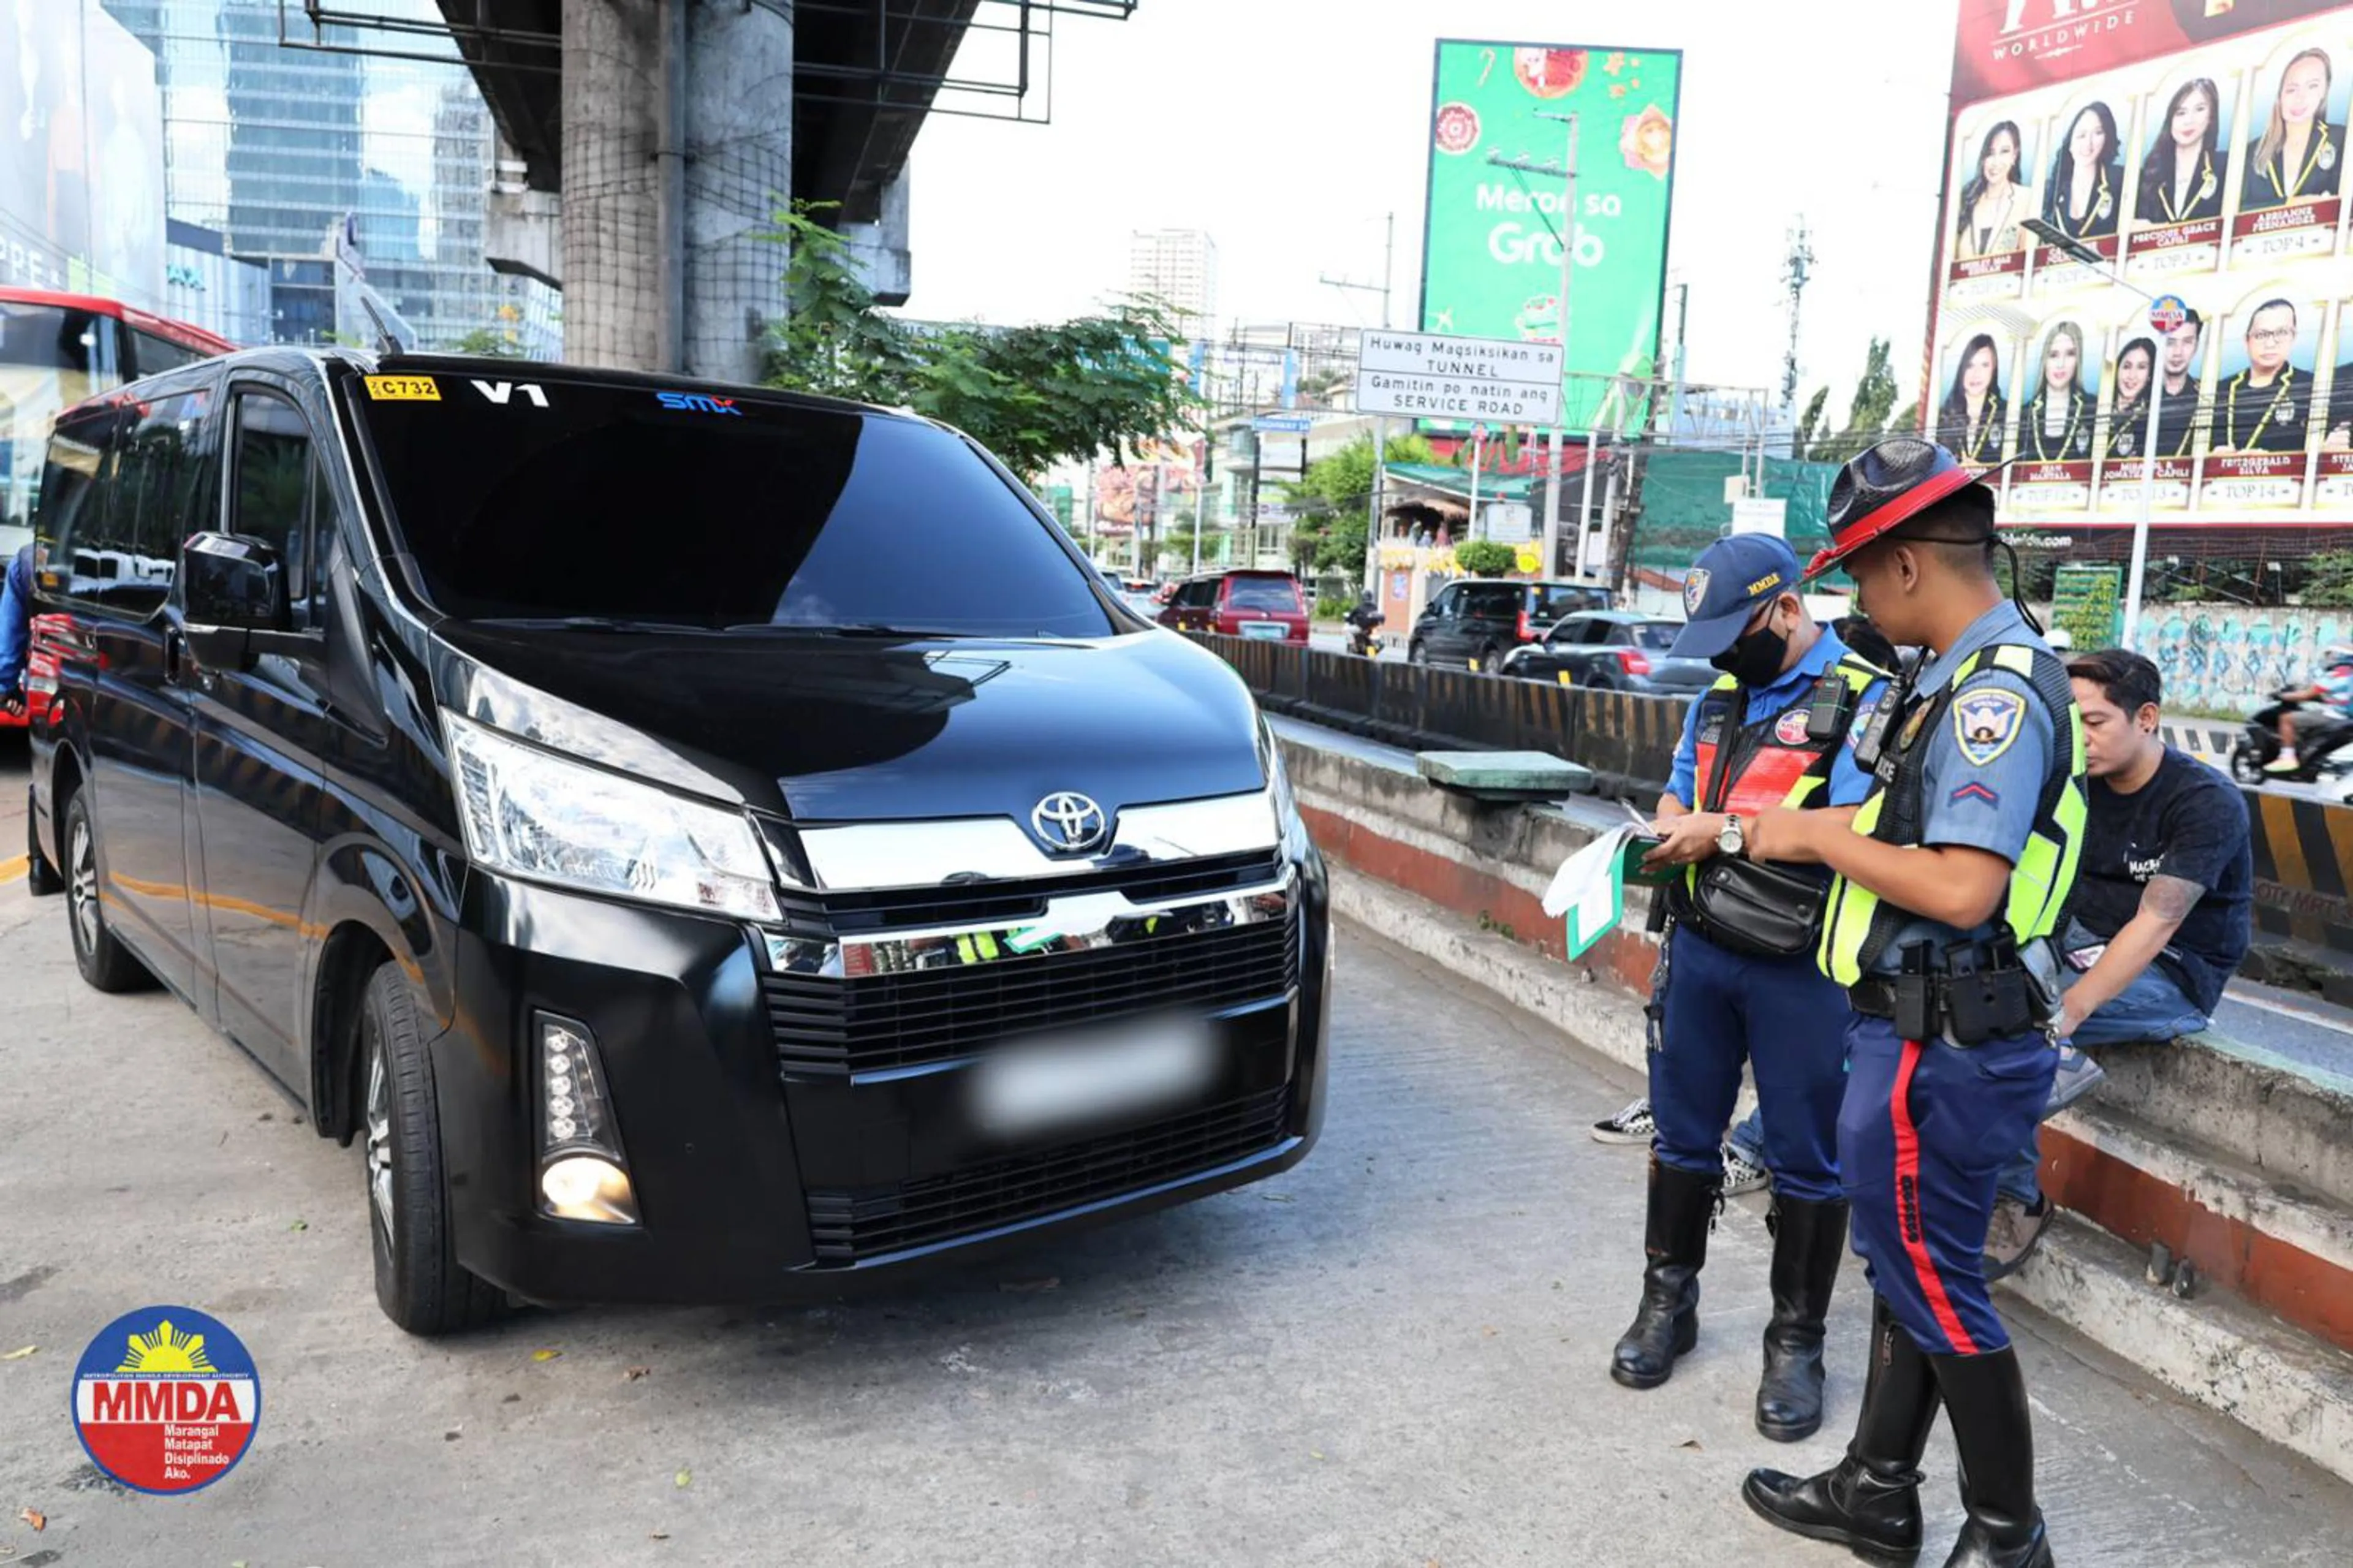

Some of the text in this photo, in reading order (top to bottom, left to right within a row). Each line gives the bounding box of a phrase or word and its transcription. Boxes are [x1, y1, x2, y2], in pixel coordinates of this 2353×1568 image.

[1993, 10, 2135, 60] WORLDWIDE
[1585, 193, 1621, 216] sa
[1488, 221, 1604, 268] Grab
[1370, 337, 1555, 363] Huwag Magsiksikan sa
[1427, 359, 1499, 377] TUNNEL
[382, 381, 436, 395] C732
[470, 379, 550, 407] V1
[1371, 376, 1548, 403] Gamitin po natin ang
[1394, 394, 1523, 415] SERVICE ROAD
[2225, 484, 2256, 498] TOP
[1748, 573, 1780, 596] MMDA
